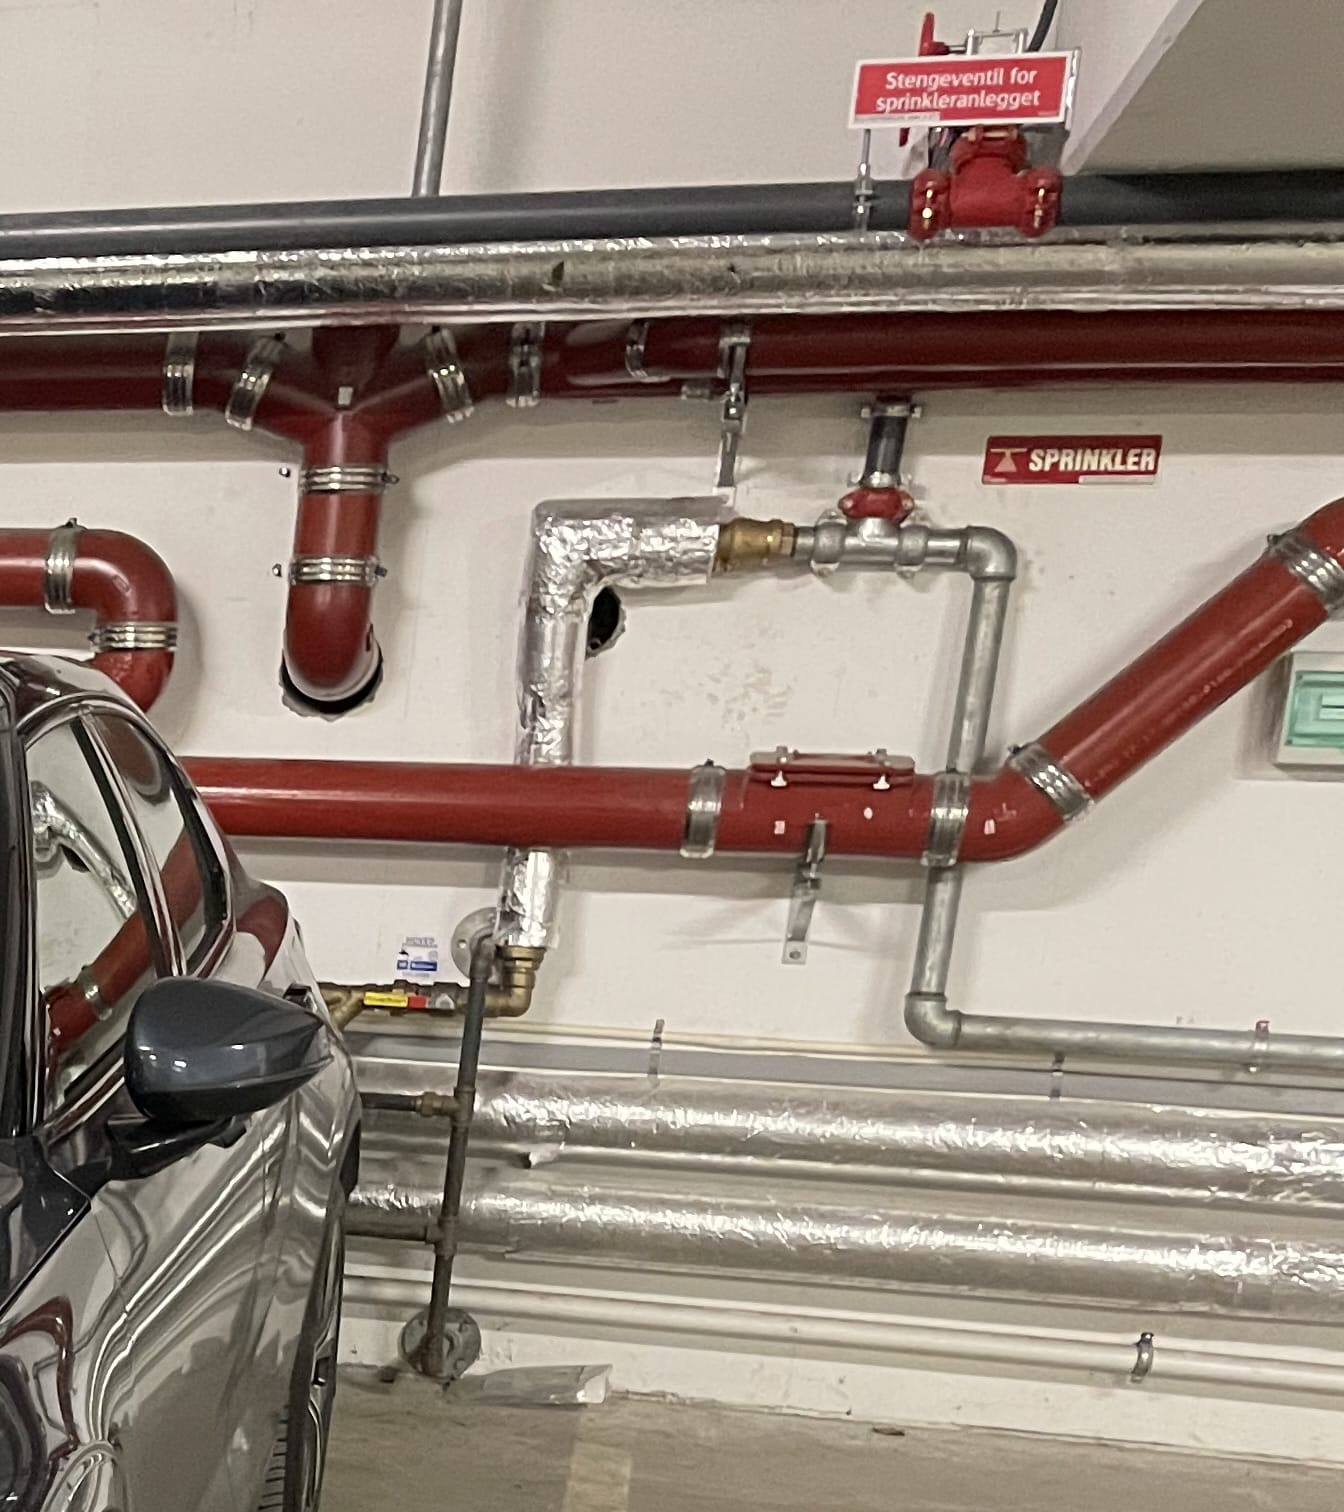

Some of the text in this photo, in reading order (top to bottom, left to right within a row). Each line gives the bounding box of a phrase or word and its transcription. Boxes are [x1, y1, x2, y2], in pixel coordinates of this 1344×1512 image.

[885, 66, 1038, 91] Stengeventil for
[876, 89, 1040, 113] sprinkleranlegget
[1028, 448, 1157, 472] SPRINKLER
